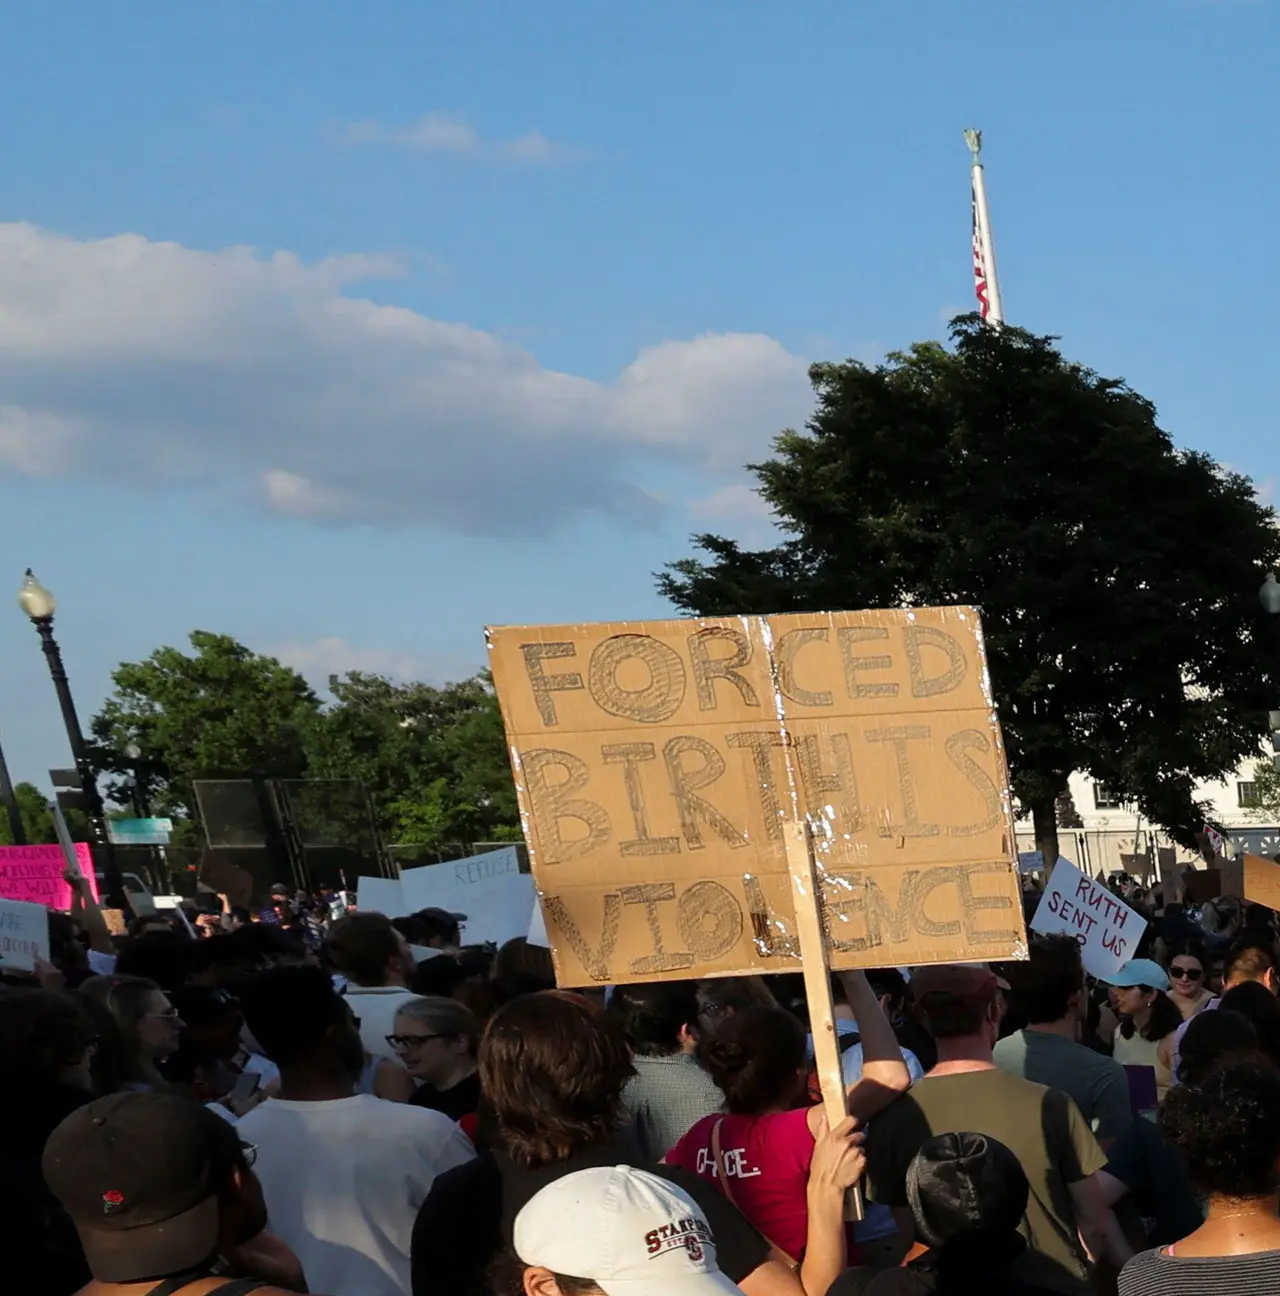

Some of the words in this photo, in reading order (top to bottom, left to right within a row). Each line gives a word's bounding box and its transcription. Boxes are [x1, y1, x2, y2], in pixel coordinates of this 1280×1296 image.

[521, 624, 970, 727] FORCED
[523, 730, 864, 866] BIRTH
[864, 725, 1005, 839] IS
[454, 854, 517, 885] REFUSE
[1076, 877, 1128, 929] RUTH
[542, 860, 1015, 982] VIOLENCE
[1048, 891, 1098, 936] SENT
[1102, 928, 1127, 958] US
